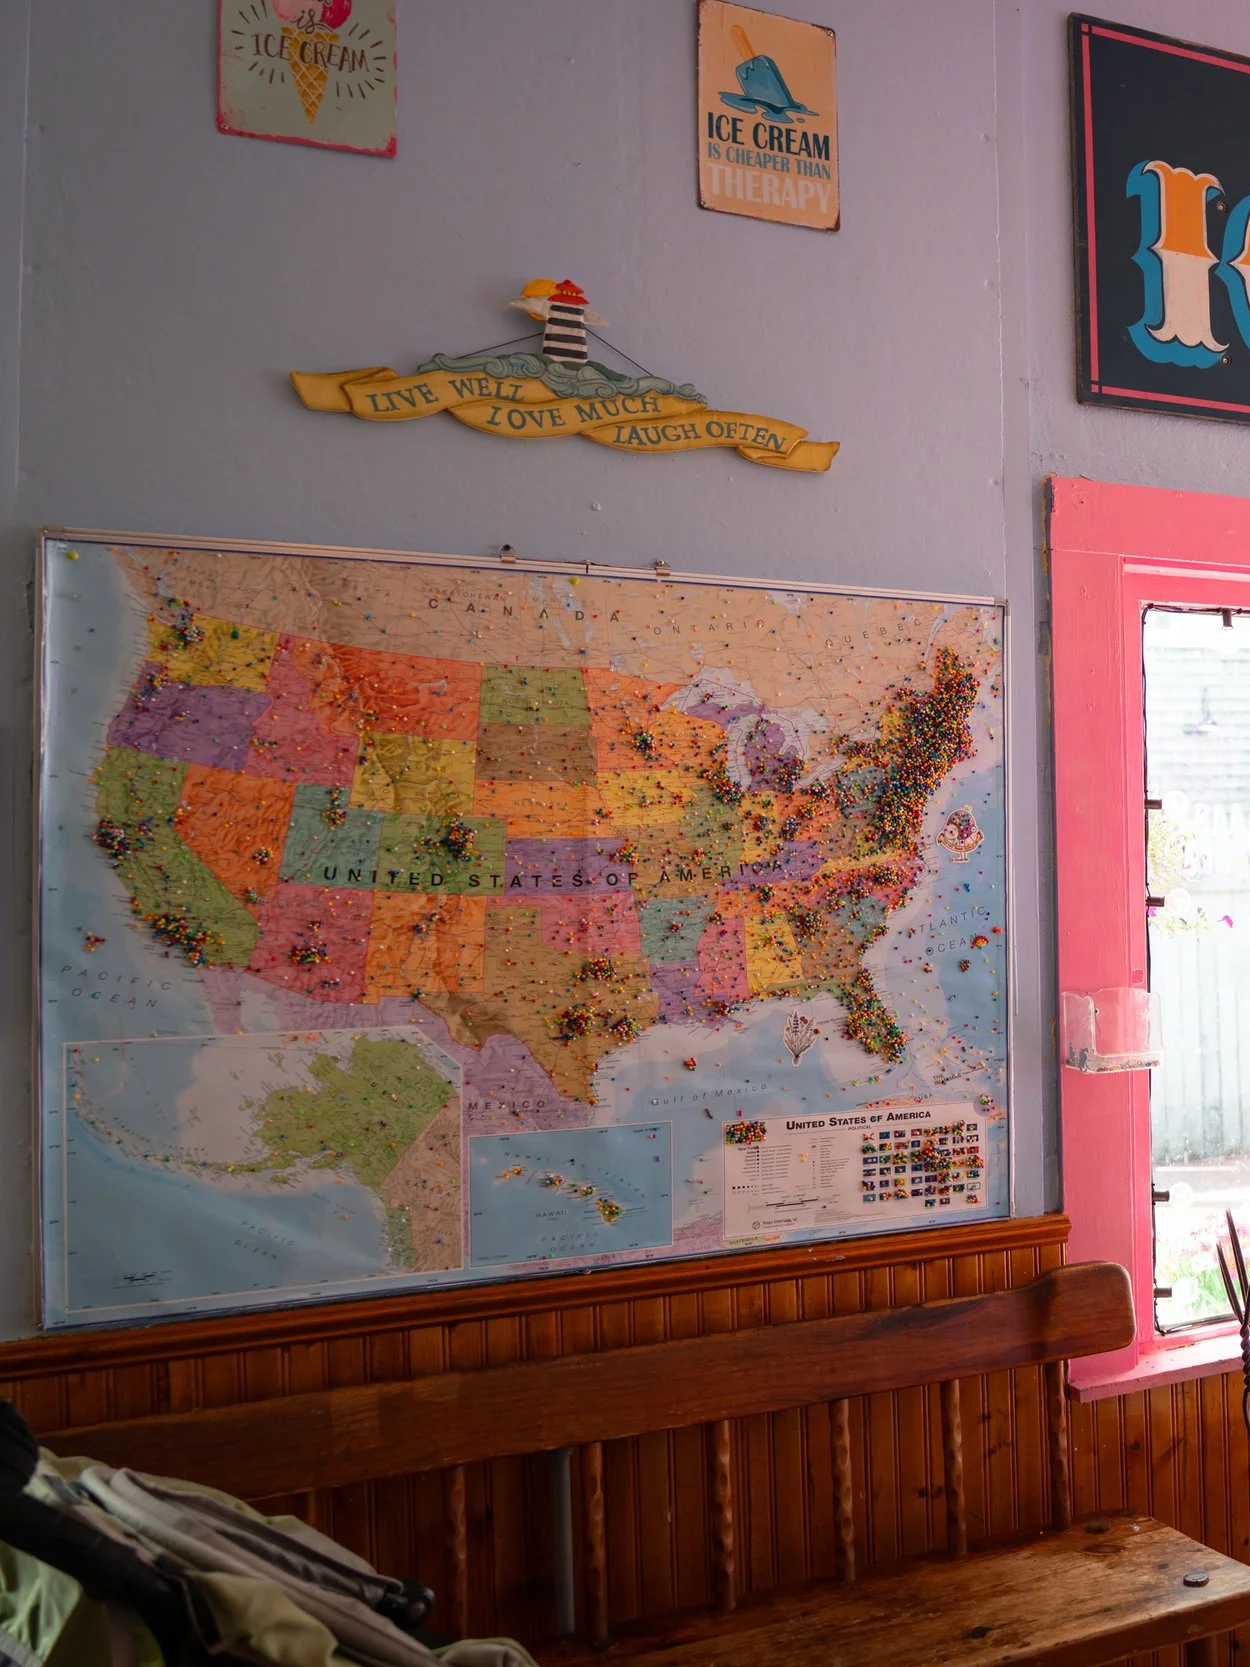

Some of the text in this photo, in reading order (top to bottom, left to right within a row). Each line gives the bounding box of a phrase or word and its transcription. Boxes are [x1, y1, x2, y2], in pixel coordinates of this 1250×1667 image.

[290, 8, 334, 34] is
[251, 32, 371, 73] ICE CREAM
[707, 111, 831, 161] ICE CREAM
[707, 141, 832, 180] IS CHEAPER THAN
[706, 161, 832, 214] THERAPY
[366, 376, 525, 413] LIVE WELL
[486, 395, 663, 432] LOVE MUCH
[614, 420, 788, 452] LAUGH OFTEN
[428, 597, 620, 623] CANADA
[653, 618, 765, 636] ONTARIO
[323, 866, 444, 886] UNITED
[468, 872, 583, 889] STATES
[606, 872, 637, 886] OF
[908, 906, 986, 936] TLANTIC
[60, 965, 171, 991] PACIFIC
[71, 987, 158, 1009] OCEAN
[468, 1099, 546, 1111] MEXICO
[692, 1092, 708, 1102] of
[714, 1082, 767, 1098] Mexico
[535, 1209, 568, 1219] HAWAII
